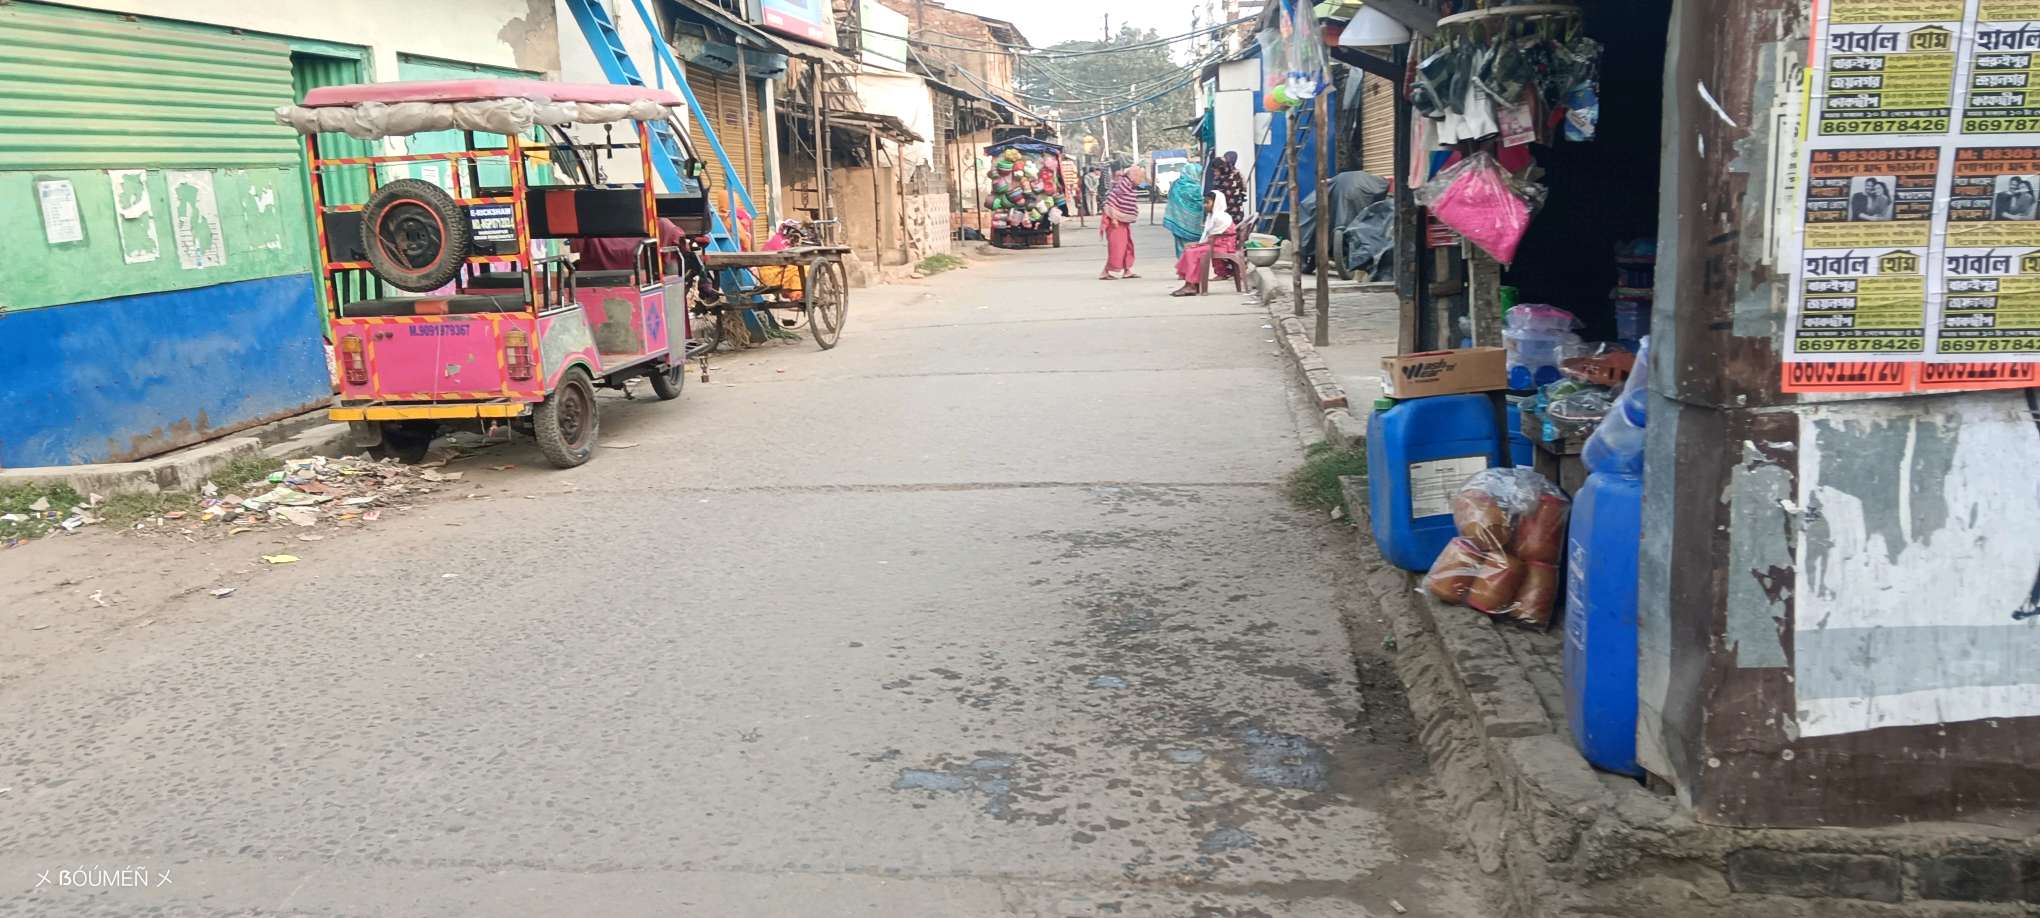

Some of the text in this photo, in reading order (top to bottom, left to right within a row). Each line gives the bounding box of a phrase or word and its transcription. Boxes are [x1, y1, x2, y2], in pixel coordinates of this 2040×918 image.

[1831, 25, 1949, 51] হার্বাল হোম
[1823, 119, 1946, 133] 8697878426
[1807, 250, 1918, 275] হার্বাল হোম
[1946, 248, 2012, 275] হার্বাল
[1799, 339, 1920, 351] 8697878426
